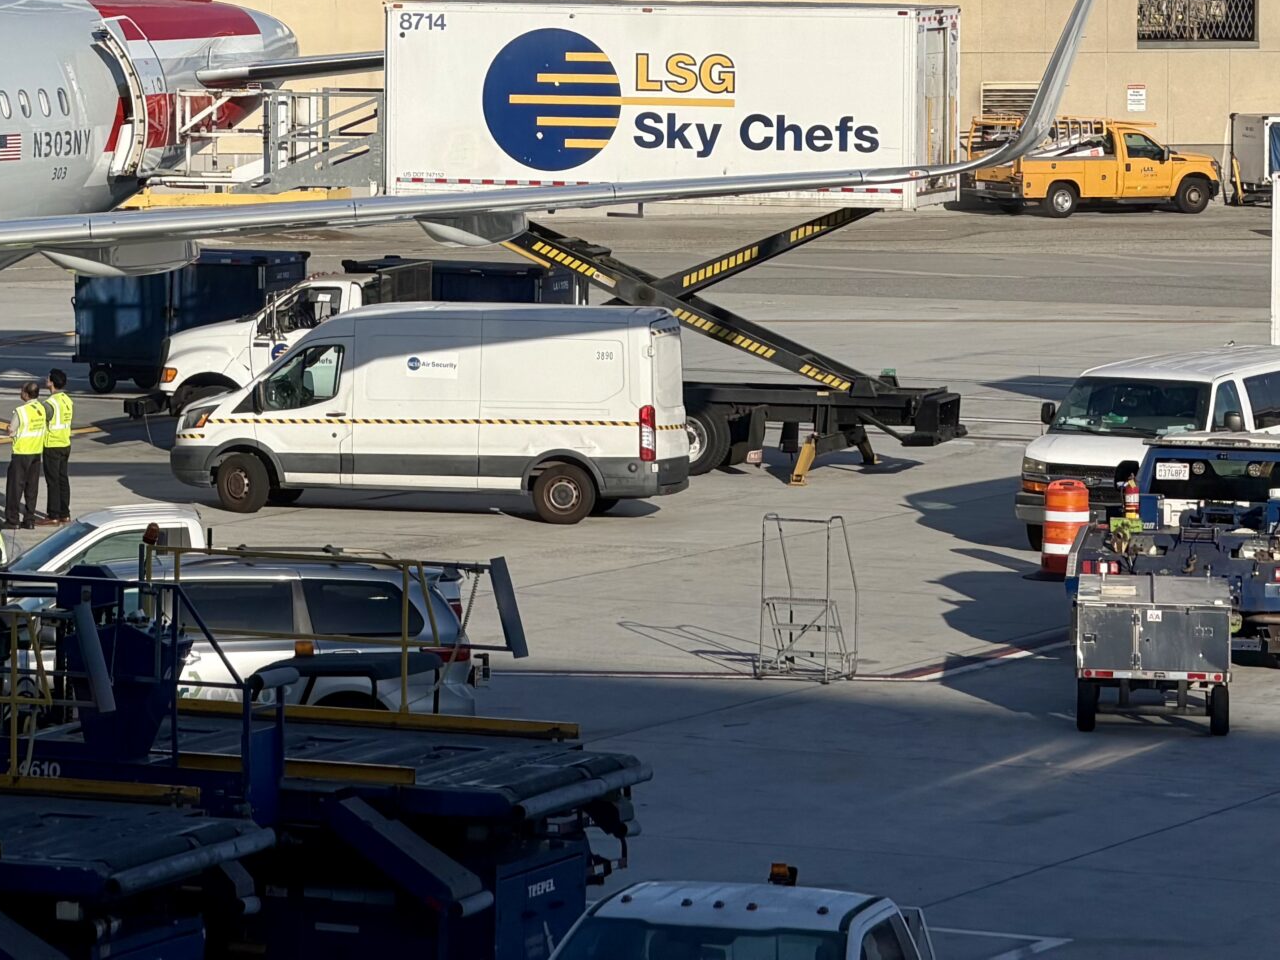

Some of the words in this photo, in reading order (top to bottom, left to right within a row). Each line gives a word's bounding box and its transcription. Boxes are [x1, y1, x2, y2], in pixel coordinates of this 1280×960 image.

[399, 12, 447, 30] 8714
[635, 52, 735, 93] LSG
[33, 129, 91, 158] N303NY
[633, 111, 722, 158] Sky
[739, 113, 880, 153] Chefs
[51, 166, 68, 180] 303
[596, 351, 614, 360] 3890
[431, 361, 457, 370] Security
[7, 760, 61, 778] 4610
